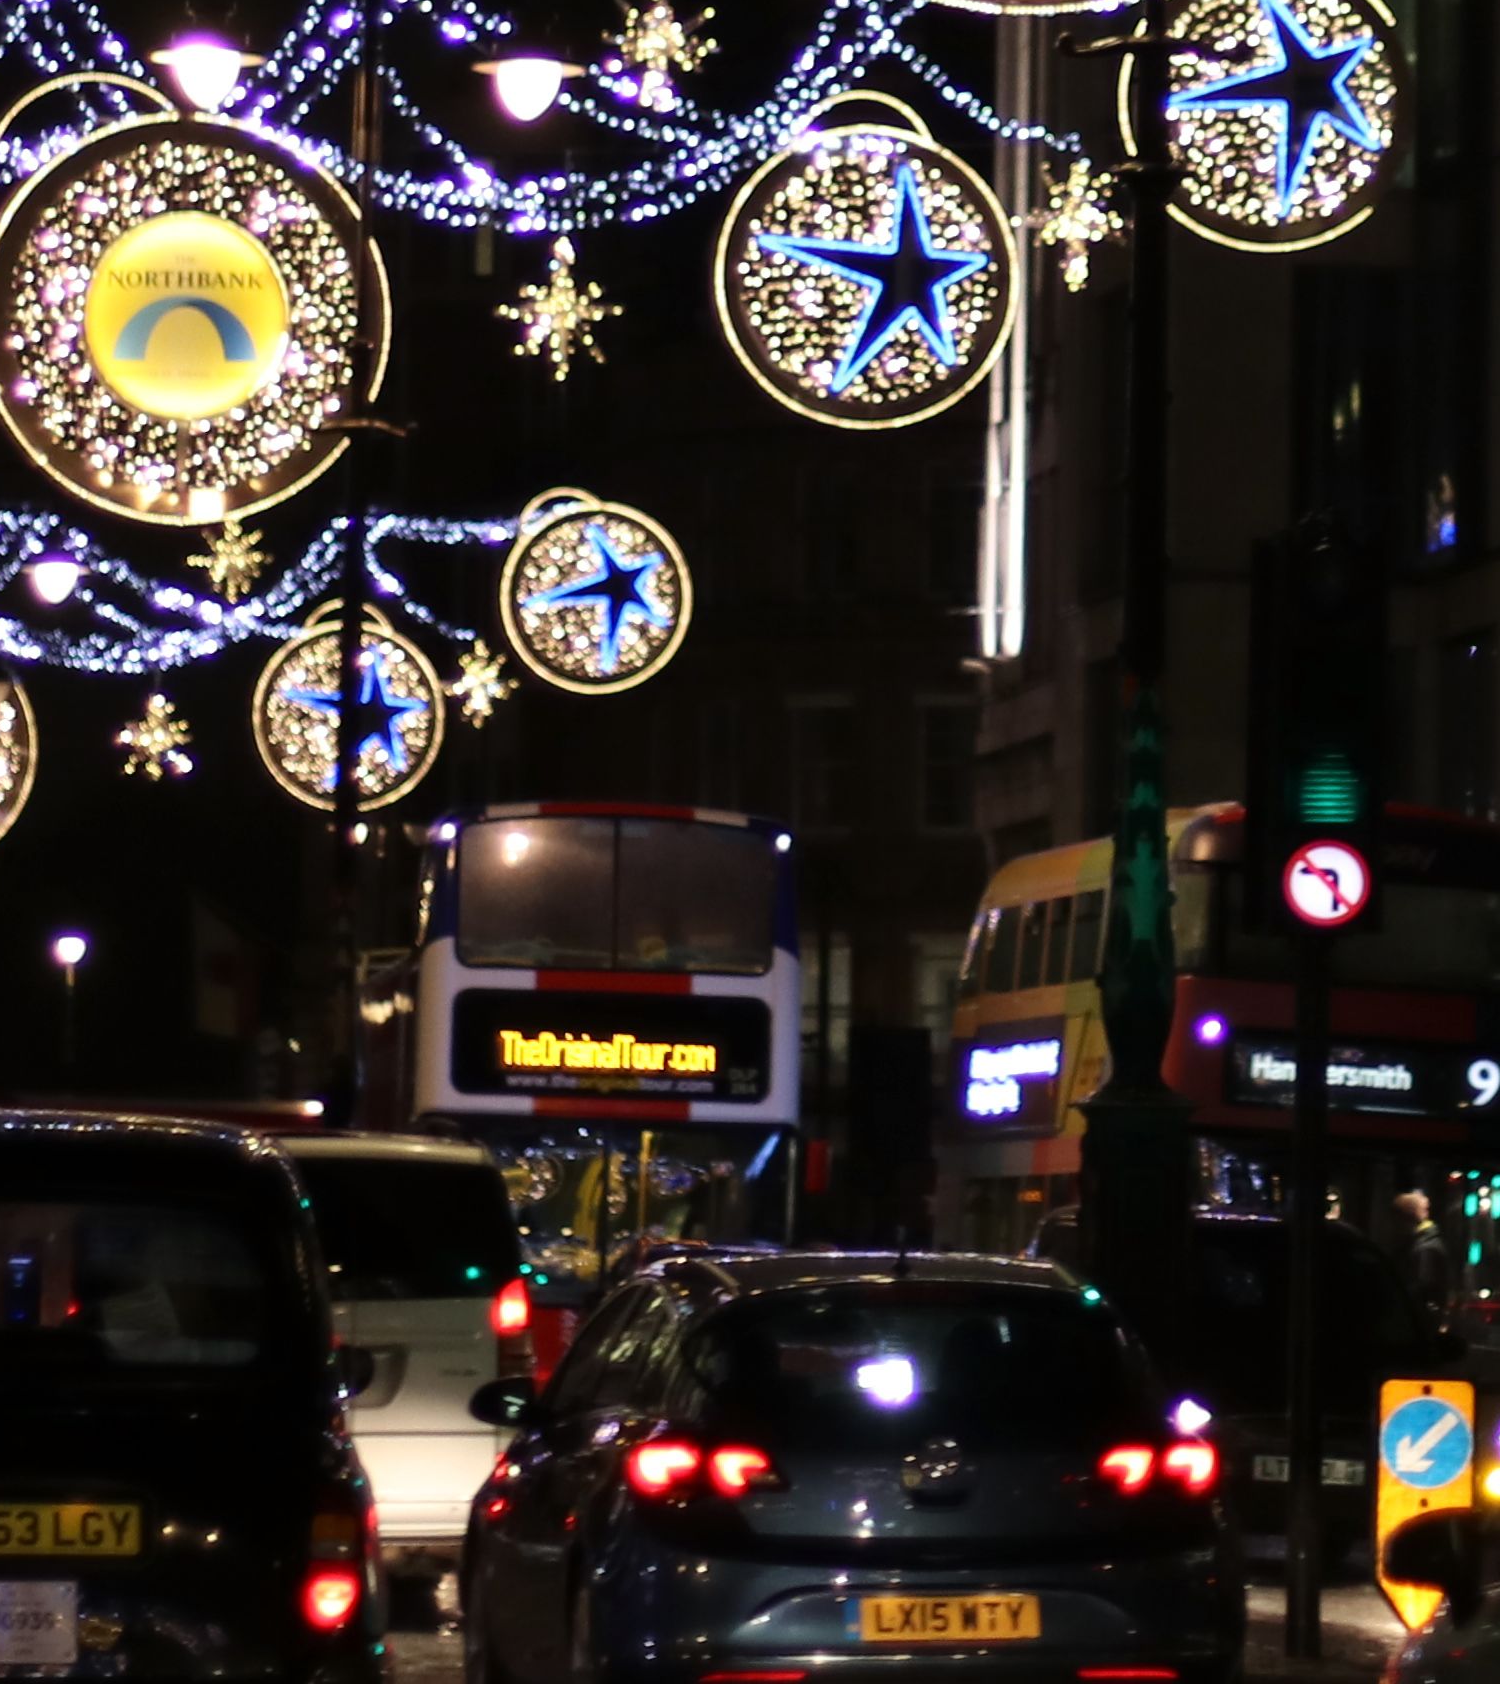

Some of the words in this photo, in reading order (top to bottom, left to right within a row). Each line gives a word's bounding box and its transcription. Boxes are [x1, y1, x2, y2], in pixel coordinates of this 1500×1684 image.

[107, 269, 263, 292] NORTHBANK
[499, 1029, 717, 1073] TheOriginalTour.com
[52, 1511, 134, 1549] LGY
[873, 1597, 950, 1634] LX15
[961, 1600, 1026, 1638] WTY
